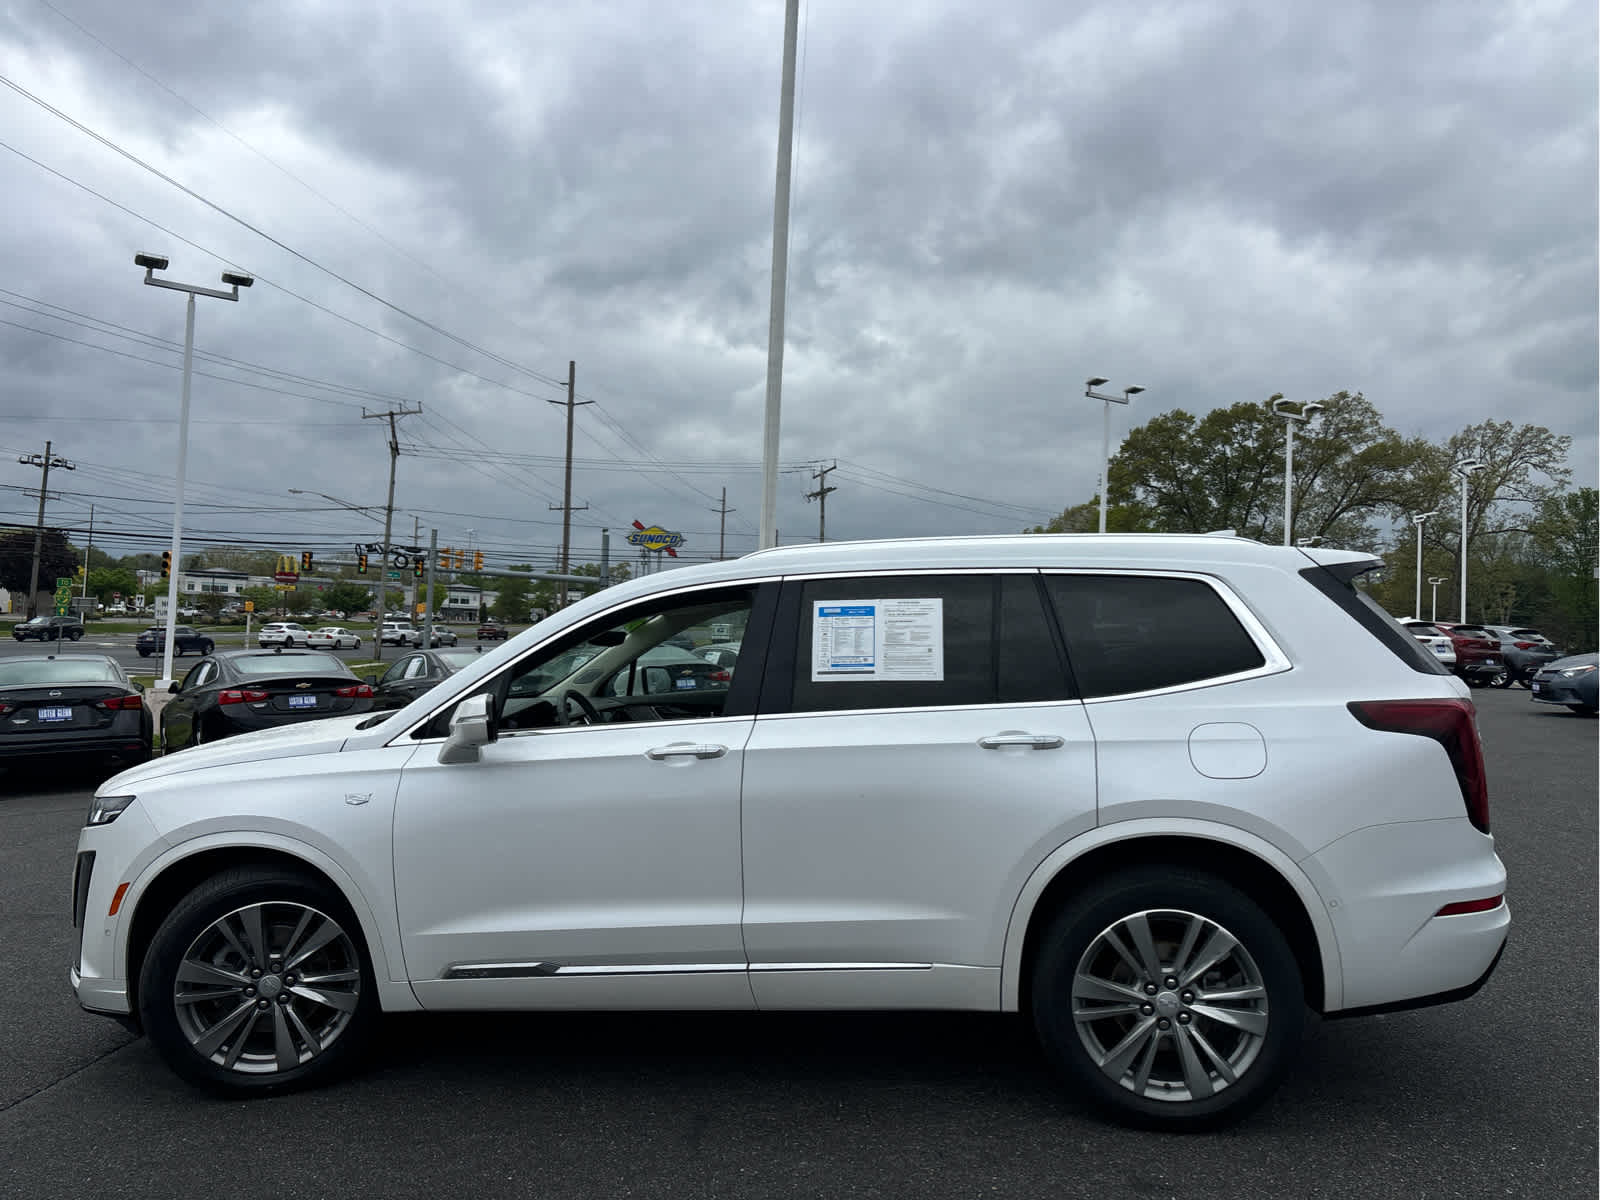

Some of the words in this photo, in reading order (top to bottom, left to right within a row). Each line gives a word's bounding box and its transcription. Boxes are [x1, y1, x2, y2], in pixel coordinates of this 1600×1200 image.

[631, 534, 678, 543] SUNOCO
[39, 708, 56, 717] LESTER
[57, 708, 72, 716] GLENN
